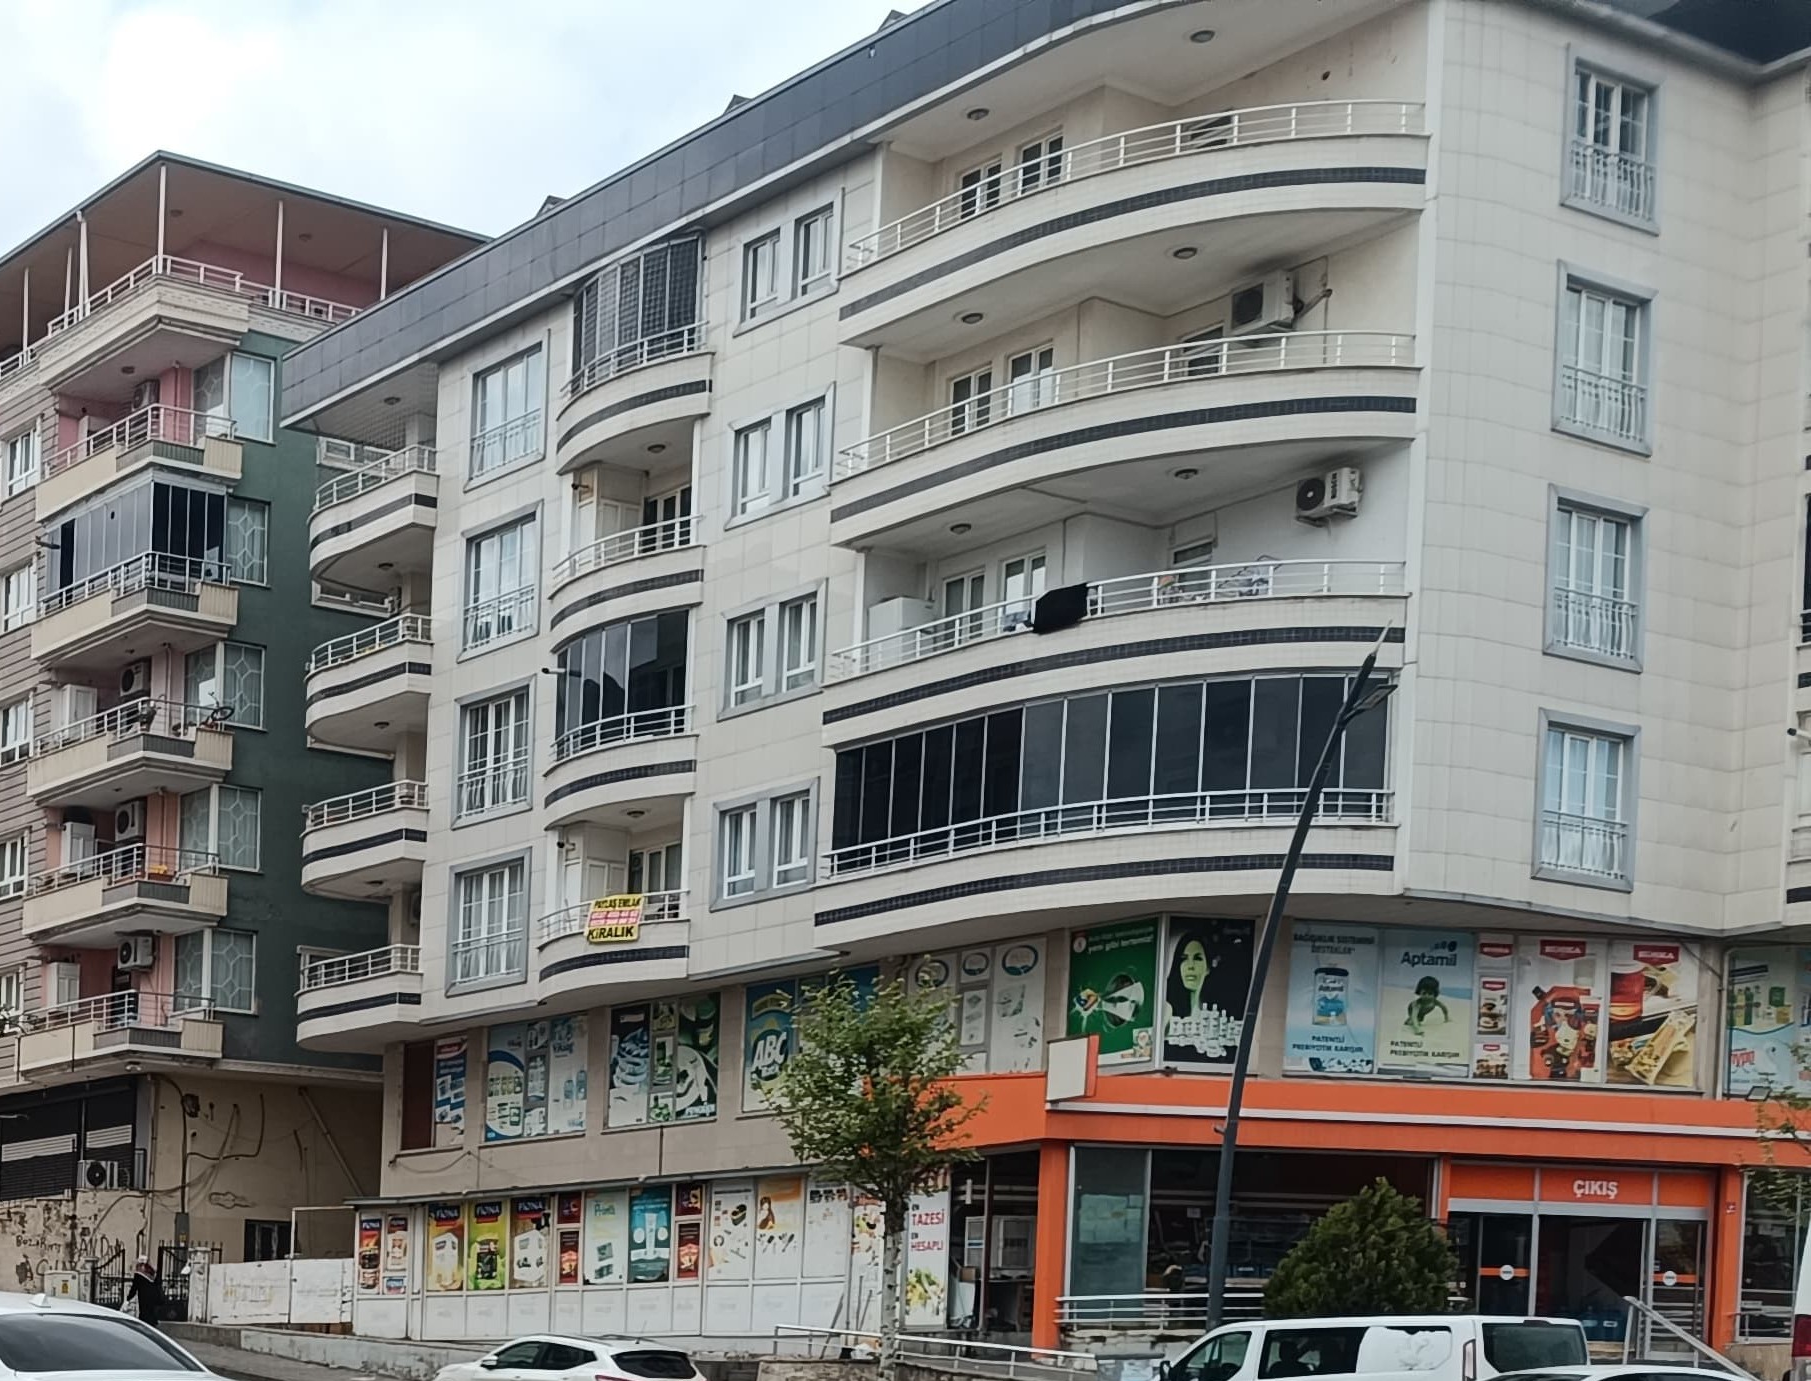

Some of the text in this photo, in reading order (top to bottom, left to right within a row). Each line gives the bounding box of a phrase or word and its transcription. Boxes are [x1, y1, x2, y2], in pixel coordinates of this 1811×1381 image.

[1401, 951, 1457, 967] Aptamil
[751, 1032, 787, 1072] ABC
[1573, 1179, 1619, 1199] ÇIKIŞ
